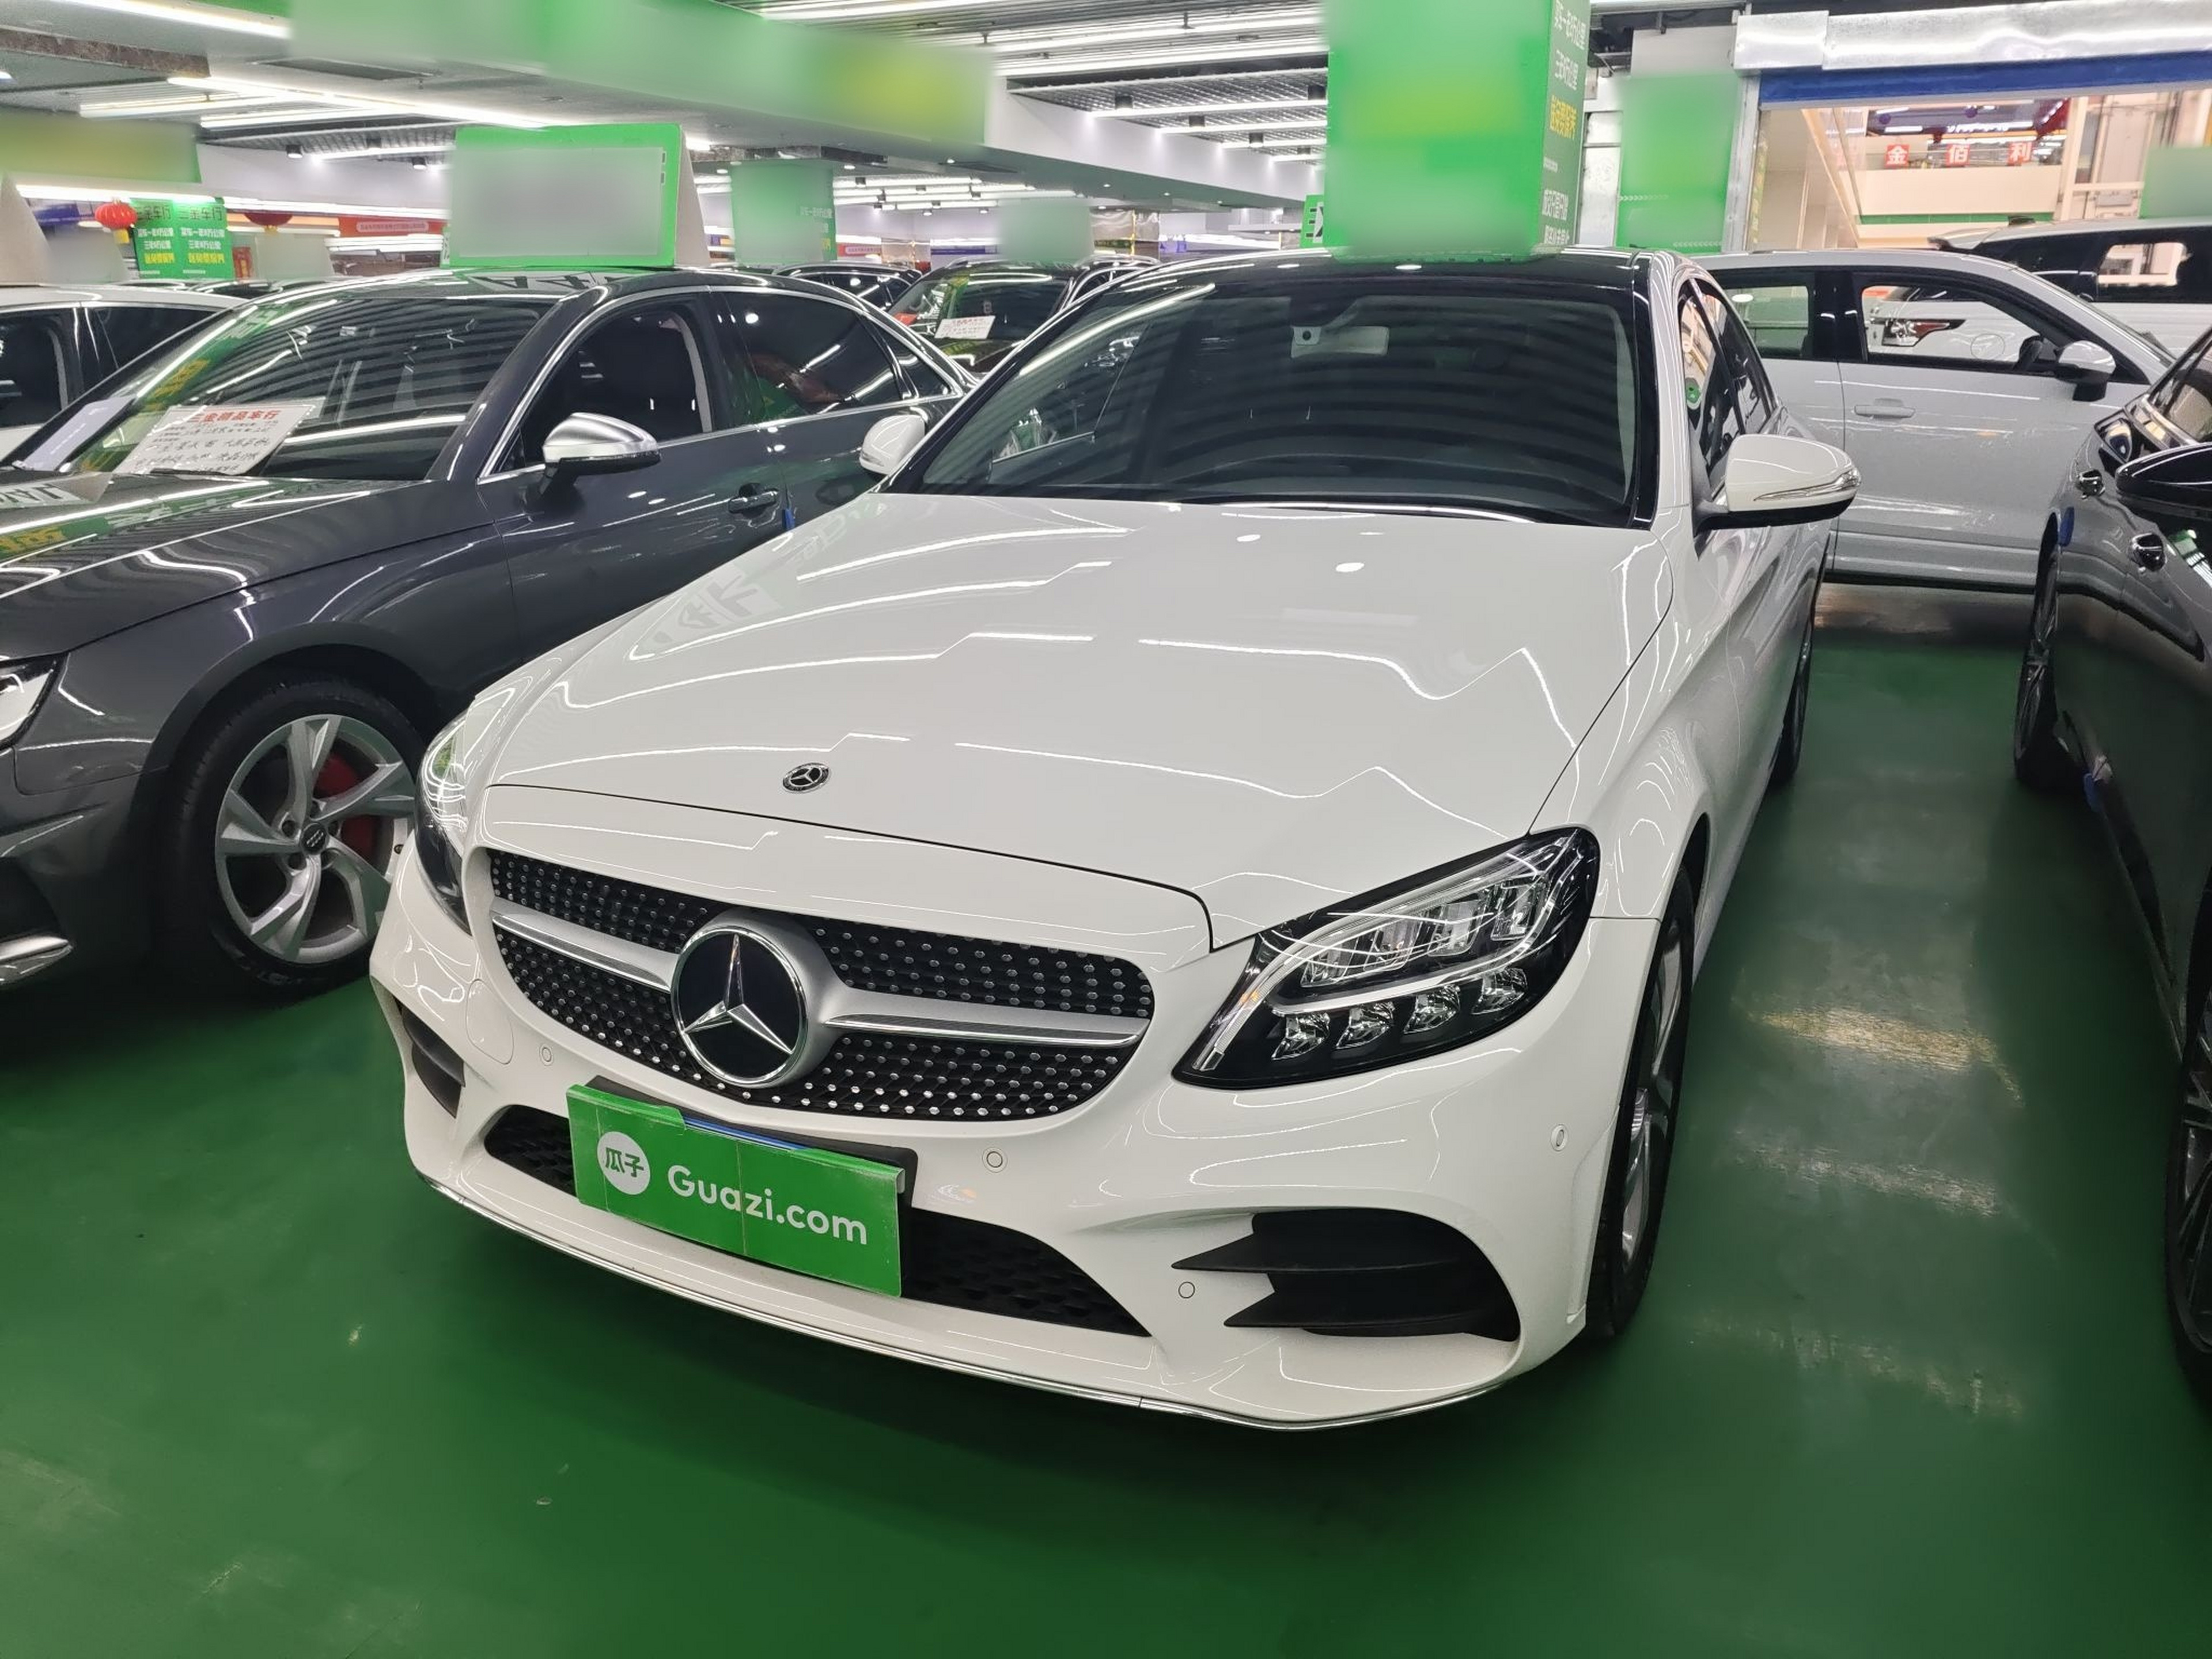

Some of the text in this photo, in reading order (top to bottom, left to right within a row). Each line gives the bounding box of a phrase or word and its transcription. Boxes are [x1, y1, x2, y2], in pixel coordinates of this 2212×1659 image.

[179, 205, 223, 221] 三金车行
[605, 1147, 868, 1245] 瓜子 Guazi.com
